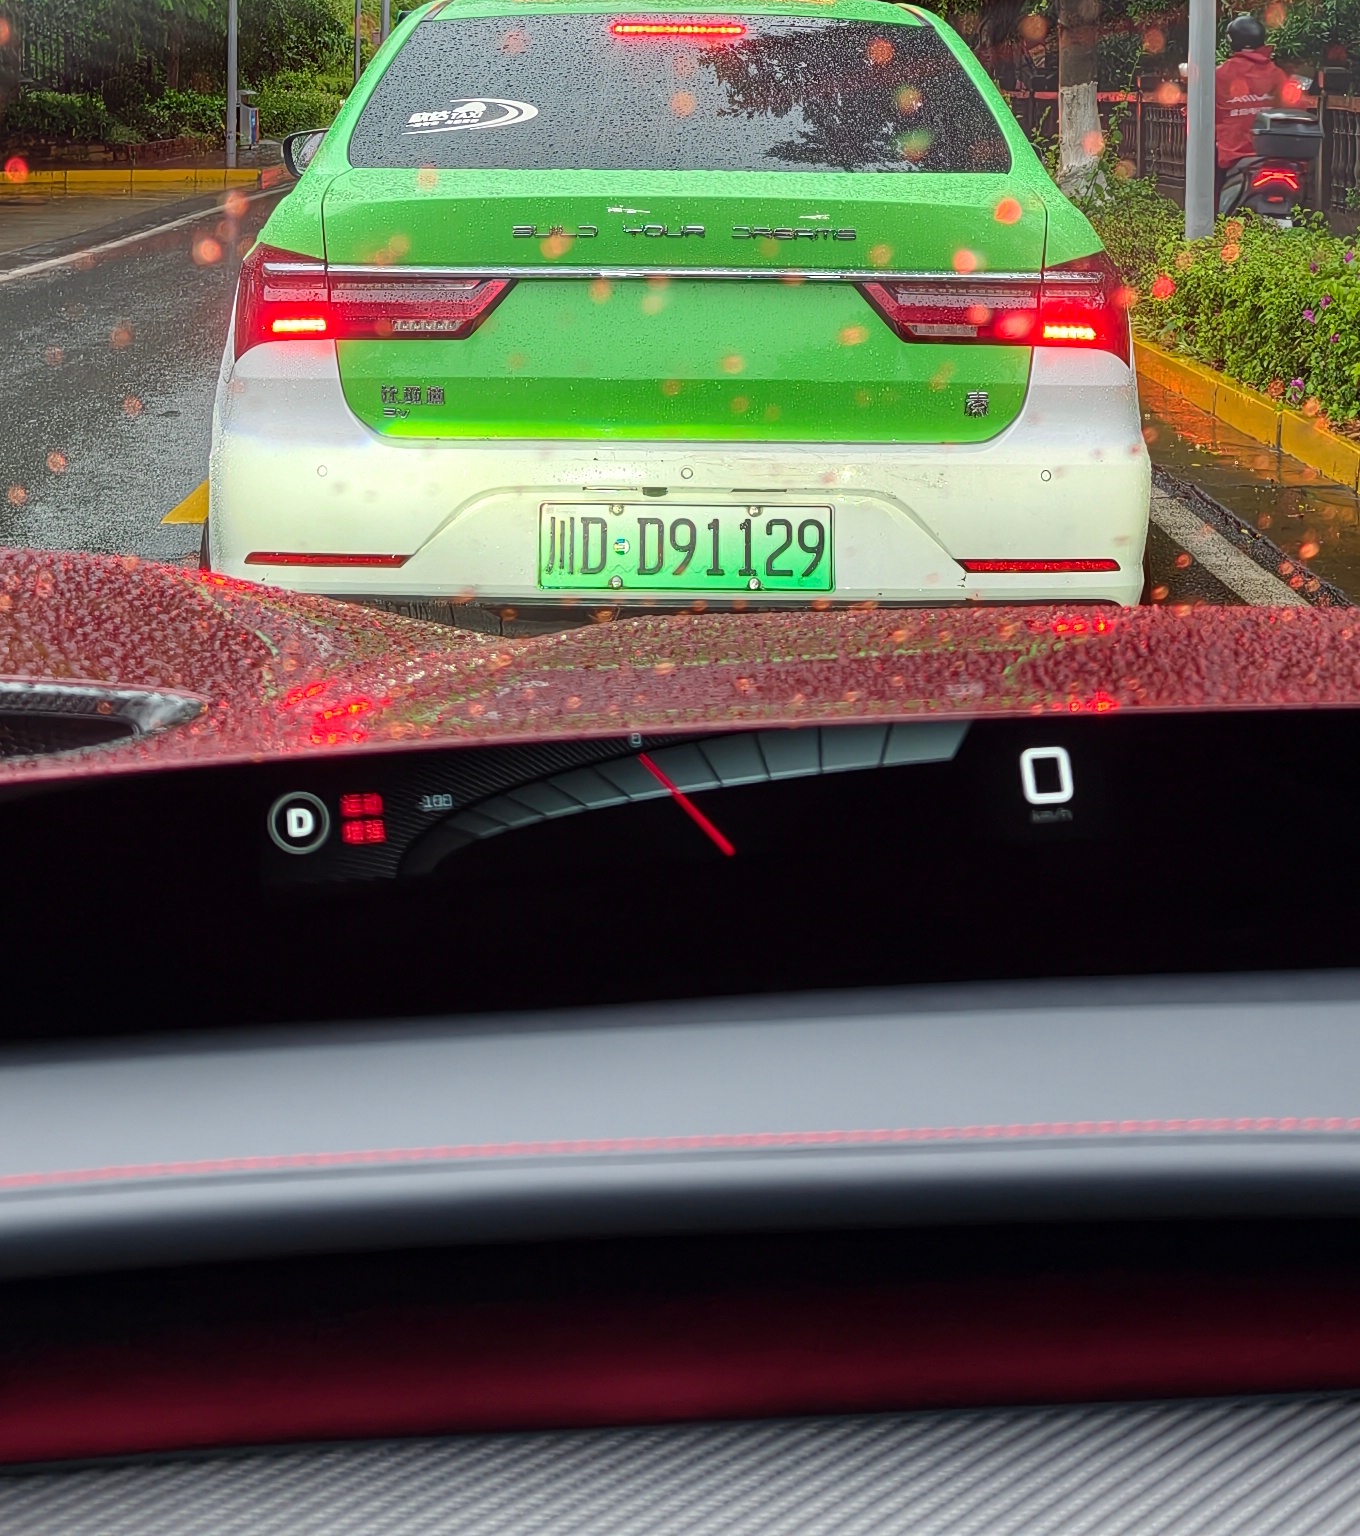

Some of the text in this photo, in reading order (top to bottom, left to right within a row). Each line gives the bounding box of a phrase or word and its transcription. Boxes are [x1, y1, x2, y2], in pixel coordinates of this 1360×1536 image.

[512, 223, 857, 242] BUILD YOUR DREAMS
[1019, 746, 1074, 805] 0
[286, 807, 315, 839] D
